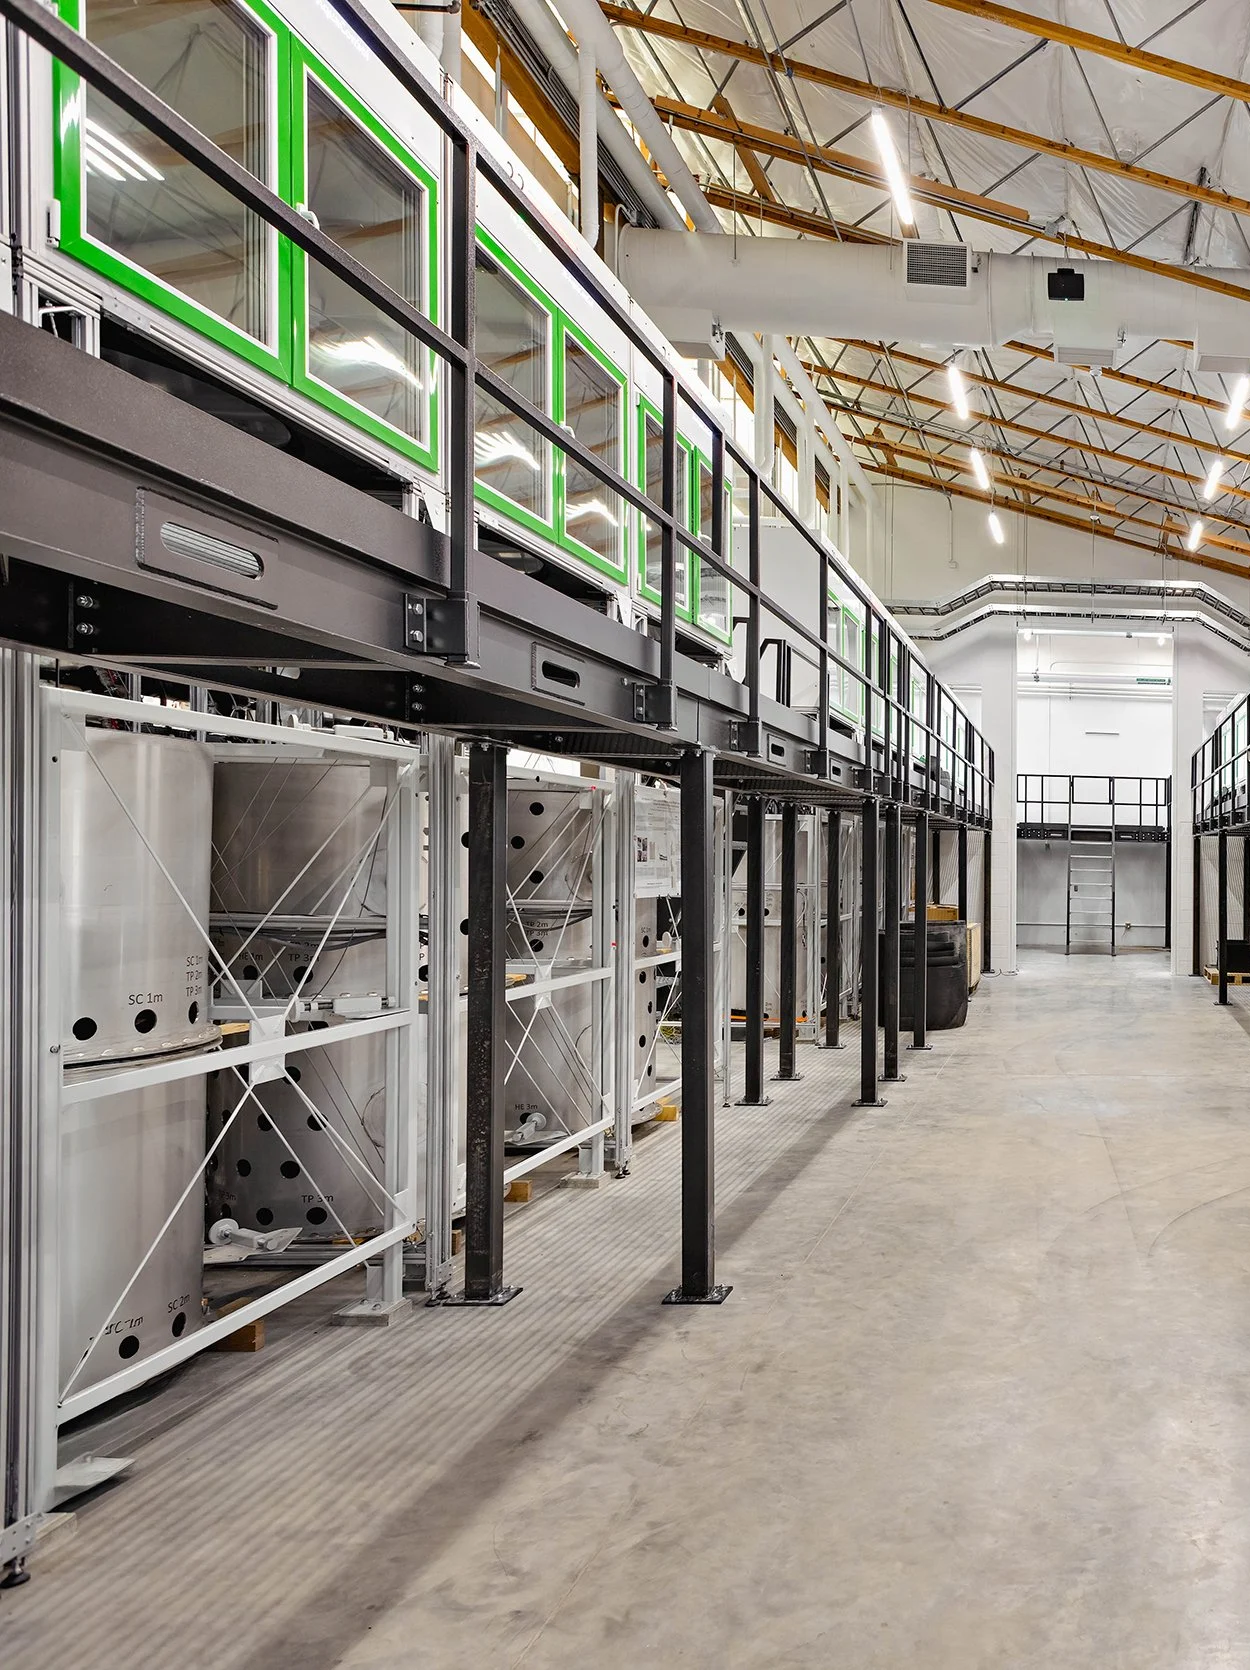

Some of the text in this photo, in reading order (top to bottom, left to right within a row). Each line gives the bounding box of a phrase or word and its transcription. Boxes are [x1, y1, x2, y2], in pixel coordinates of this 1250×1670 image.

[288, 953, 301, 962] TP
[128, 992, 163, 1006] SC 1m
[301, 1194, 315, 1203] TP
[167, 1300, 177, 1314] SC
